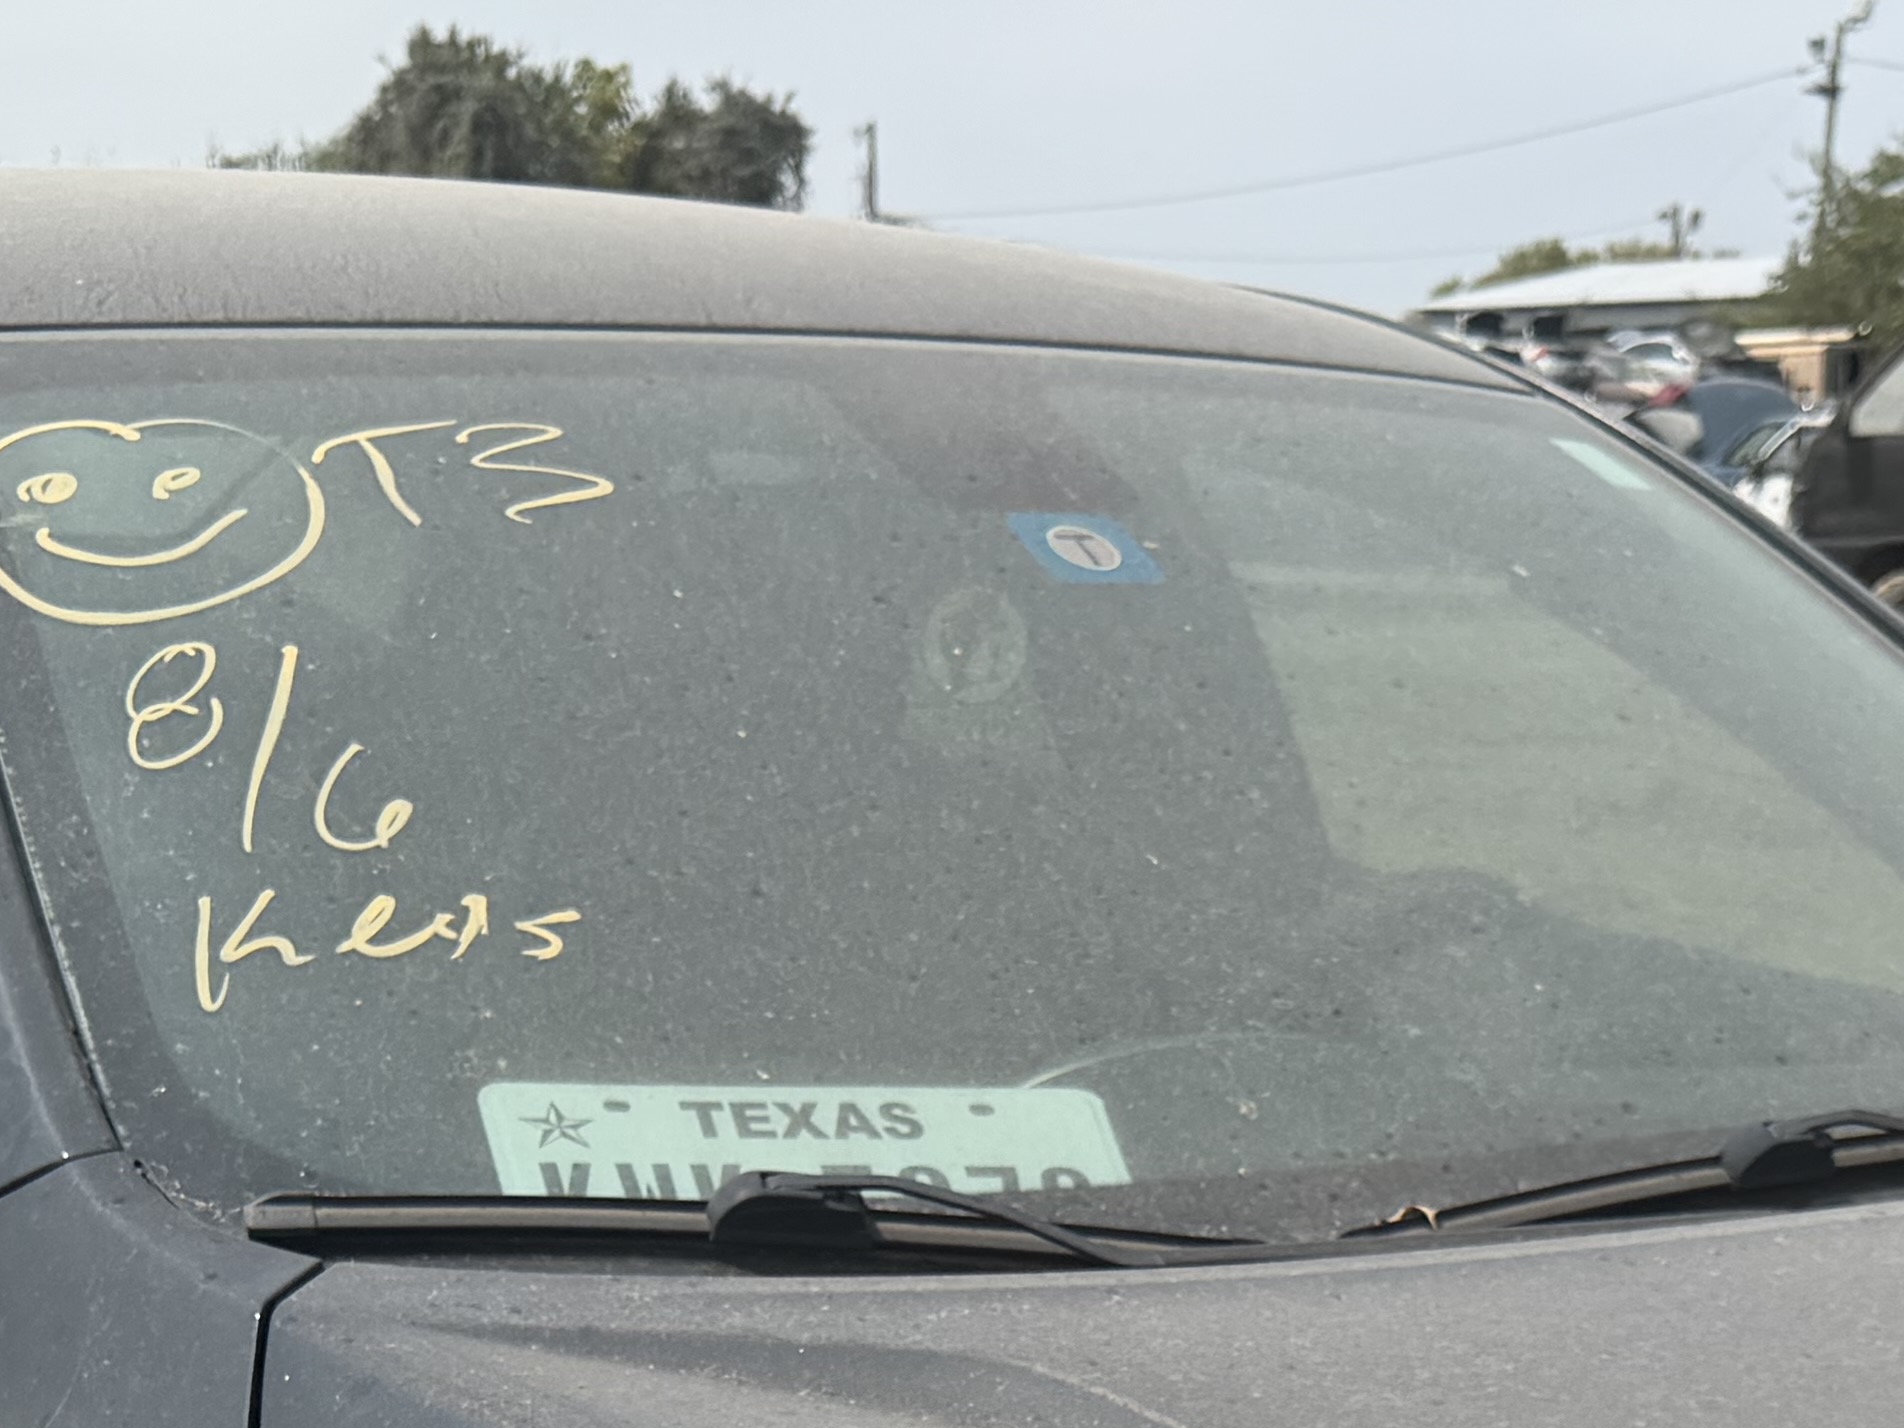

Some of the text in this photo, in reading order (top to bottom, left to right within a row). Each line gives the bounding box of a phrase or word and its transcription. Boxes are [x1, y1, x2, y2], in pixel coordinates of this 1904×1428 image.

[311, 418, 615, 526] T3
[125, 641, 414, 853] 8/6
[678, 1100, 926, 1140] TEXAS
